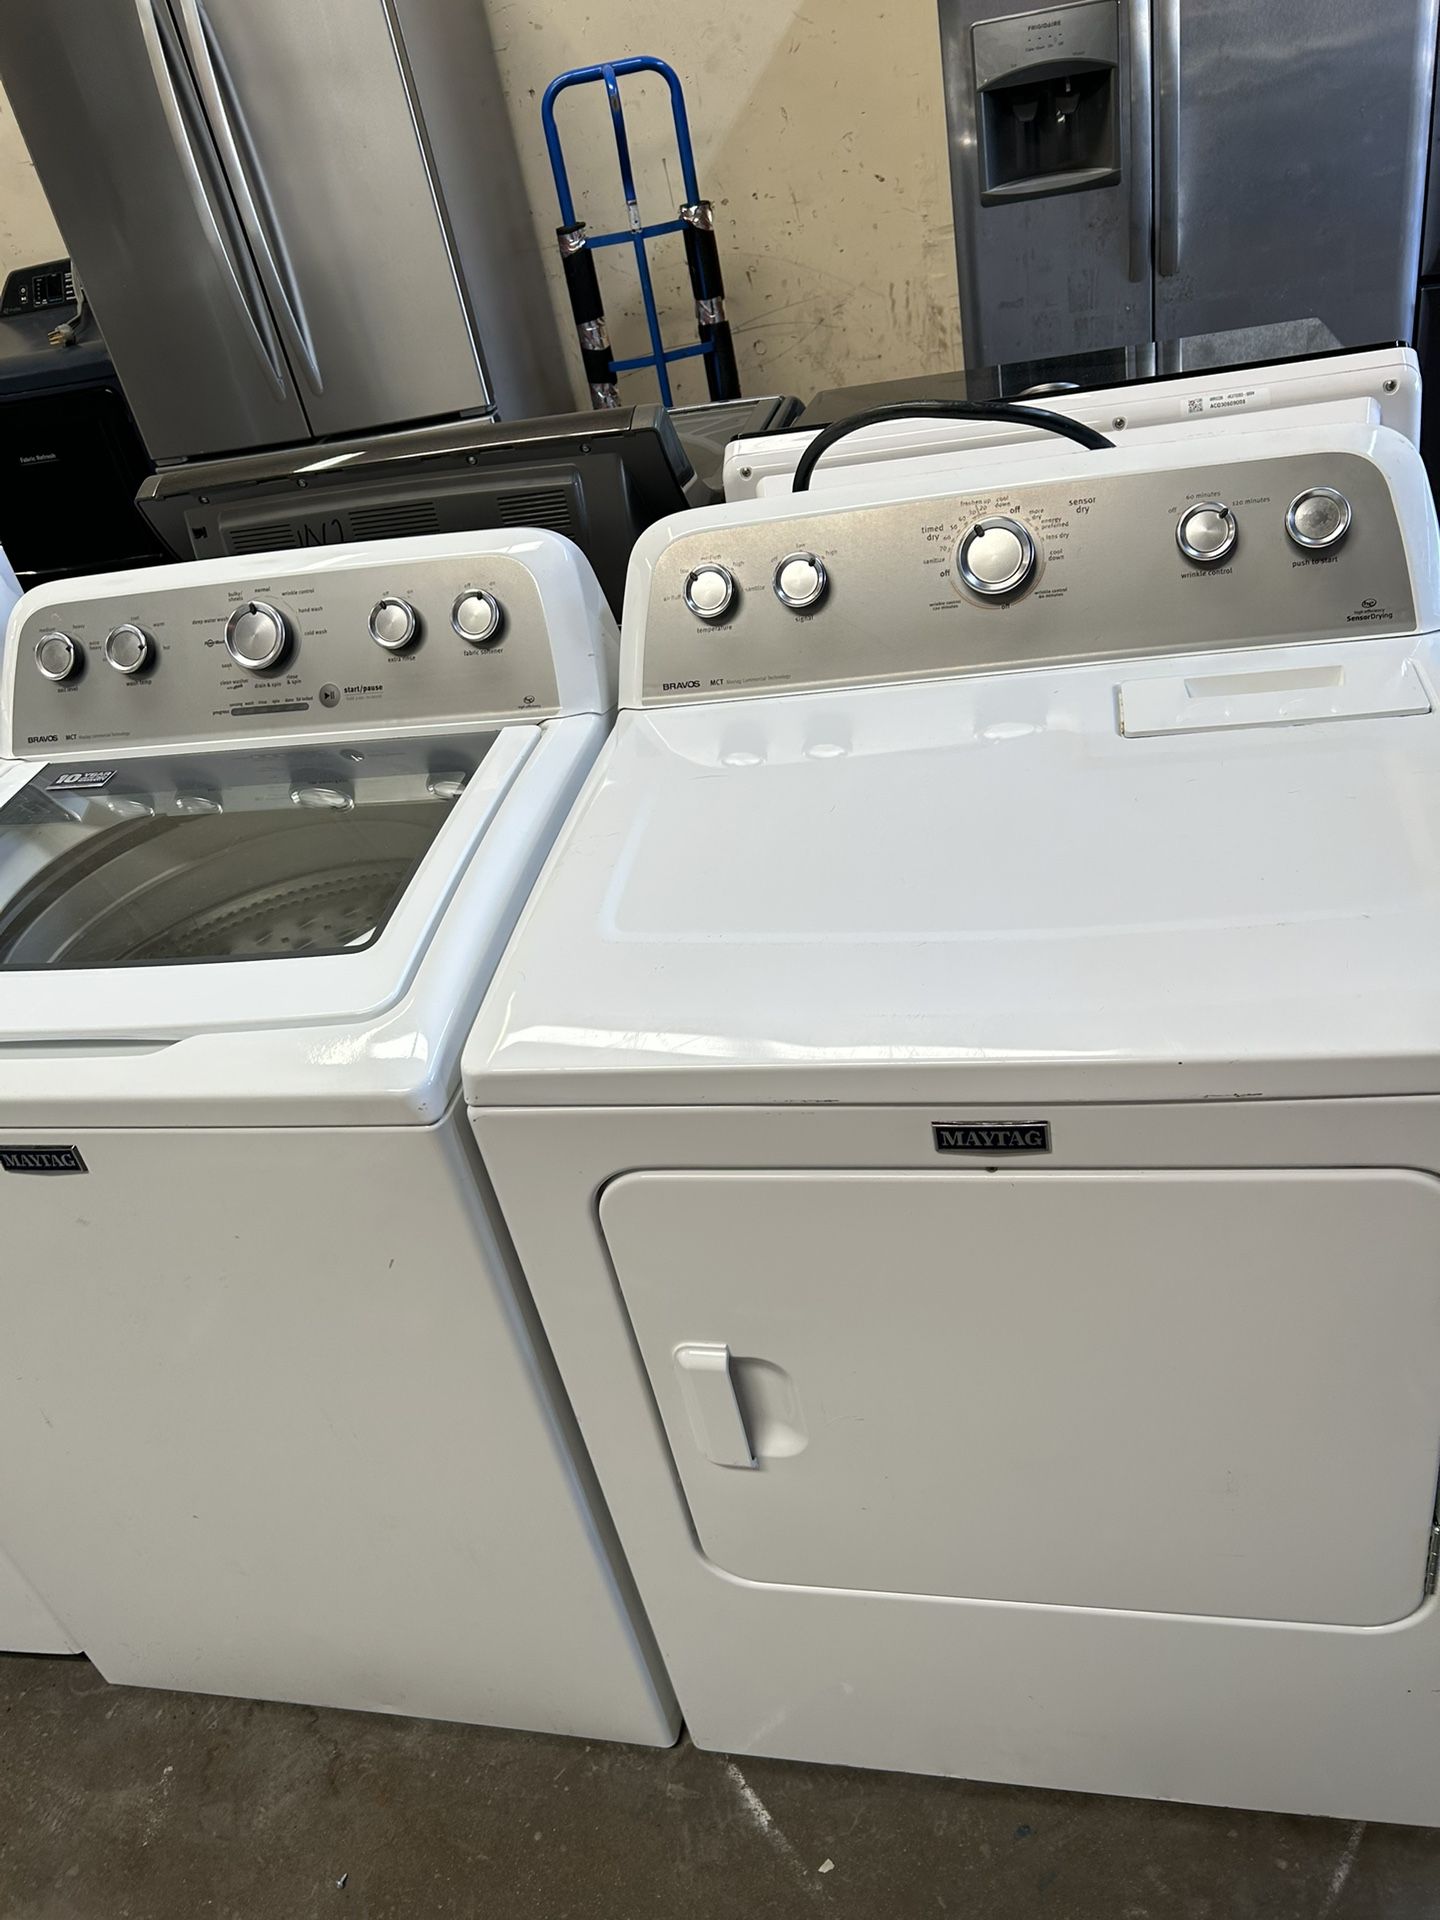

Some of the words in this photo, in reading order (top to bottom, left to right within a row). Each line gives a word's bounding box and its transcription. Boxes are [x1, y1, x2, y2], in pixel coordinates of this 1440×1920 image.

[1195, 490, 1222, 499] minutes
[1069, 497, 1097, 507] sensor
[1244, 496, 1271, 505] minutes
[1010, 506, 1020, 514] off
[1076, 506, 1090, 515] dry
[922, 524, 944, 534] timed
[1050, 548, 1063, 556] cool
[1292, 559, 1310, 568] push
[1320, 556, 1339, 564] start
[940, 569, 950, 578] off
[1181, 570, 1207, 580] wrinkle
[1208, 567, 1233, 577] control
[795, 615, 814, 623] signal
[1346, 613, 1393, 622] SensorDrying
[697, 625, 732, 634] temperature
[464, 649, 480, 657] fabric
[388, 656, 402, 664] extra
[662, 680, 700, 691] BRAVOS
[710, 678, 724, 686] MCT
[344, 685, 383, 694] start/pause
[28, 734, 58, 744] BRAVOS
[56, 774, 82, 784] 10
[941, 1130, 1042, 1146] MAYTAG
[2, 1153, 76, 1167] MAYTAG
